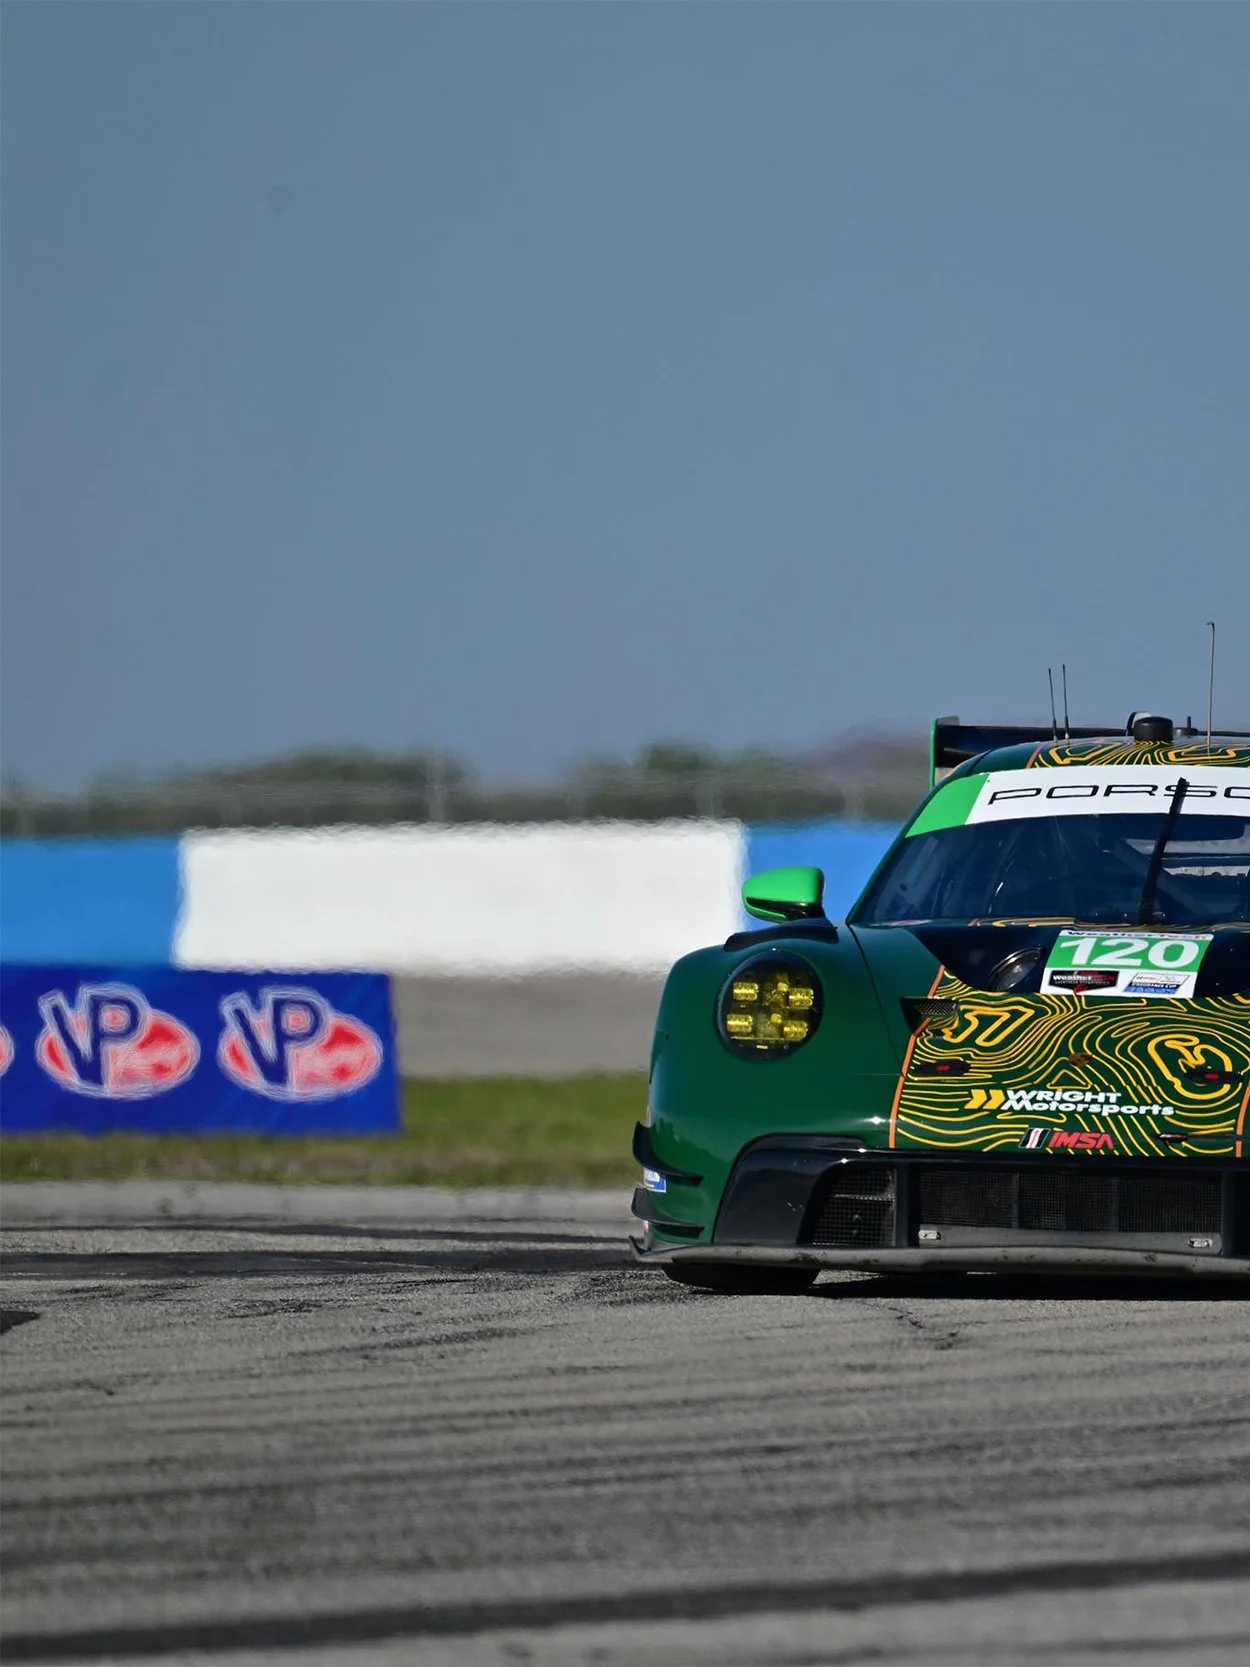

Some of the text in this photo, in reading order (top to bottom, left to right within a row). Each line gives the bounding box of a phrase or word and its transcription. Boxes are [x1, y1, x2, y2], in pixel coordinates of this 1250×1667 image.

[1059, 937, 1200, 969] 120
[41, 984, 147, 1086] VP
[223, 987, 330, 1086] VP
[1000, 1100, 1175, 1117] Motorsports
[1005, 1089, 1122, 1103] WRIGHT
[1049, 1131, 1115, 1150] IMSA
